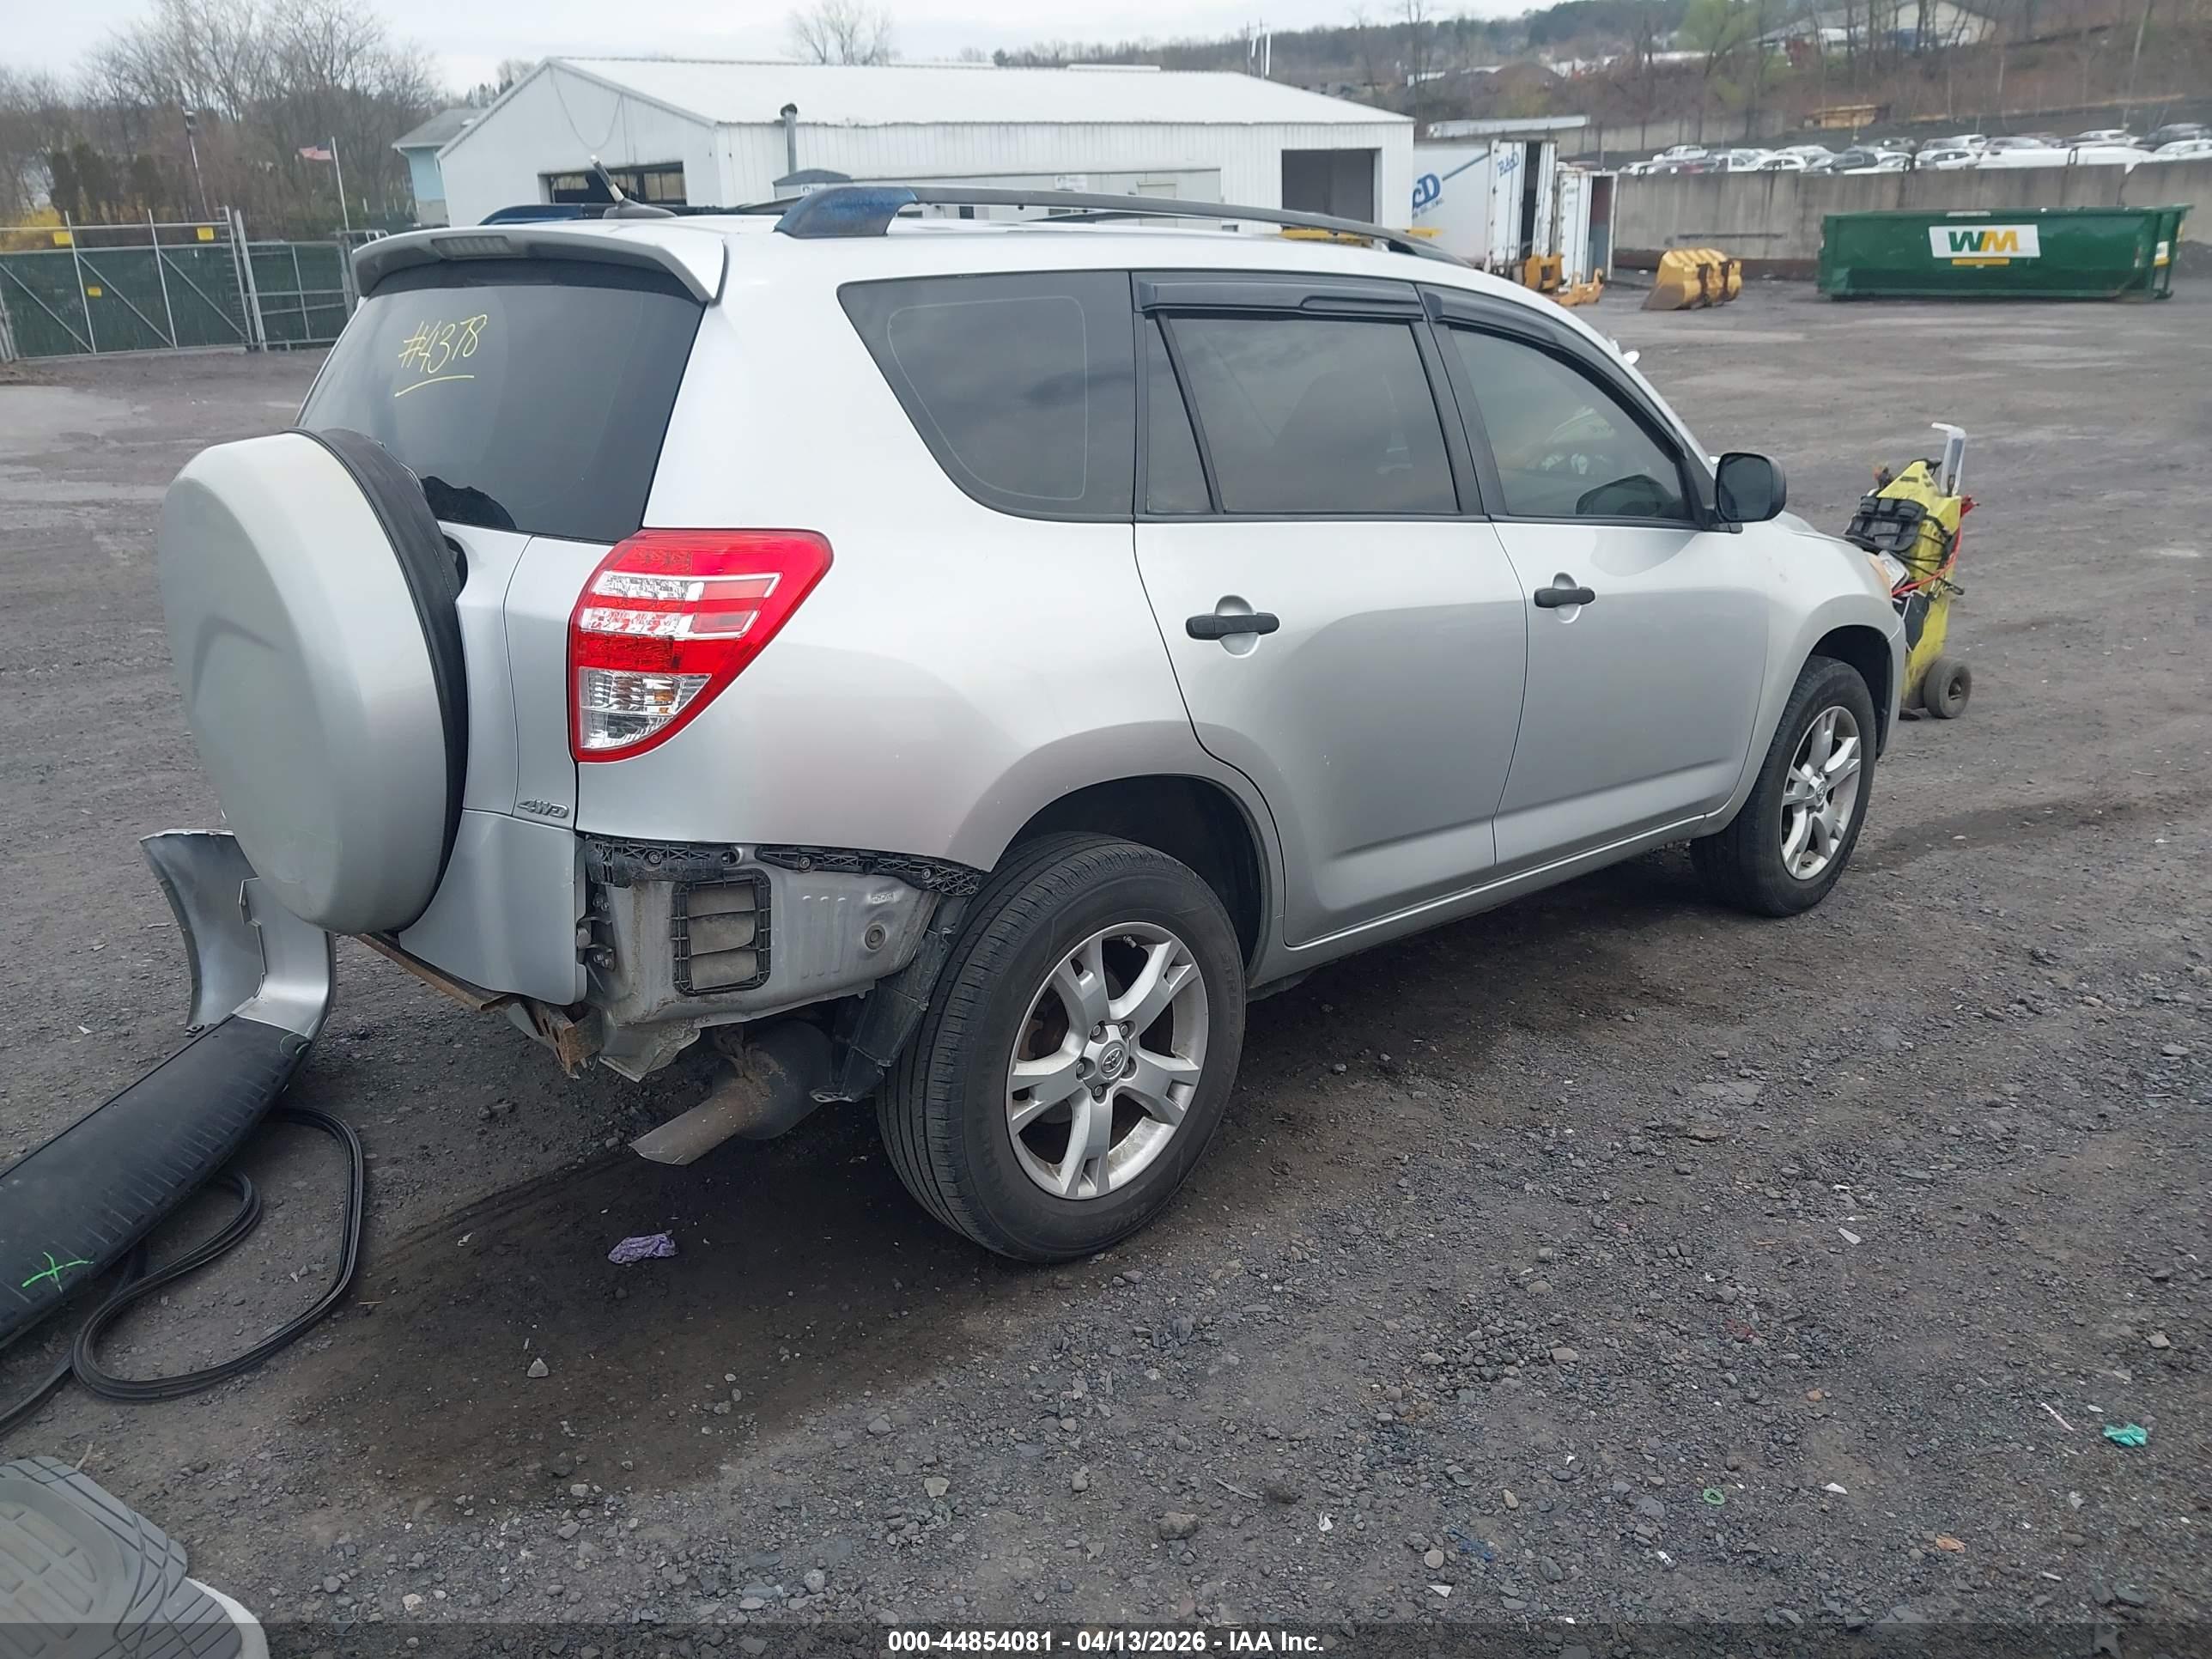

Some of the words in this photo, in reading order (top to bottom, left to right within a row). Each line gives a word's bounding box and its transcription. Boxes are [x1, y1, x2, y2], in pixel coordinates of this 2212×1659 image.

[1948, 230, 2020, 252] WM
[398, 313, 488, 374] #4378
[517, 799, 570, 819] 4WD
